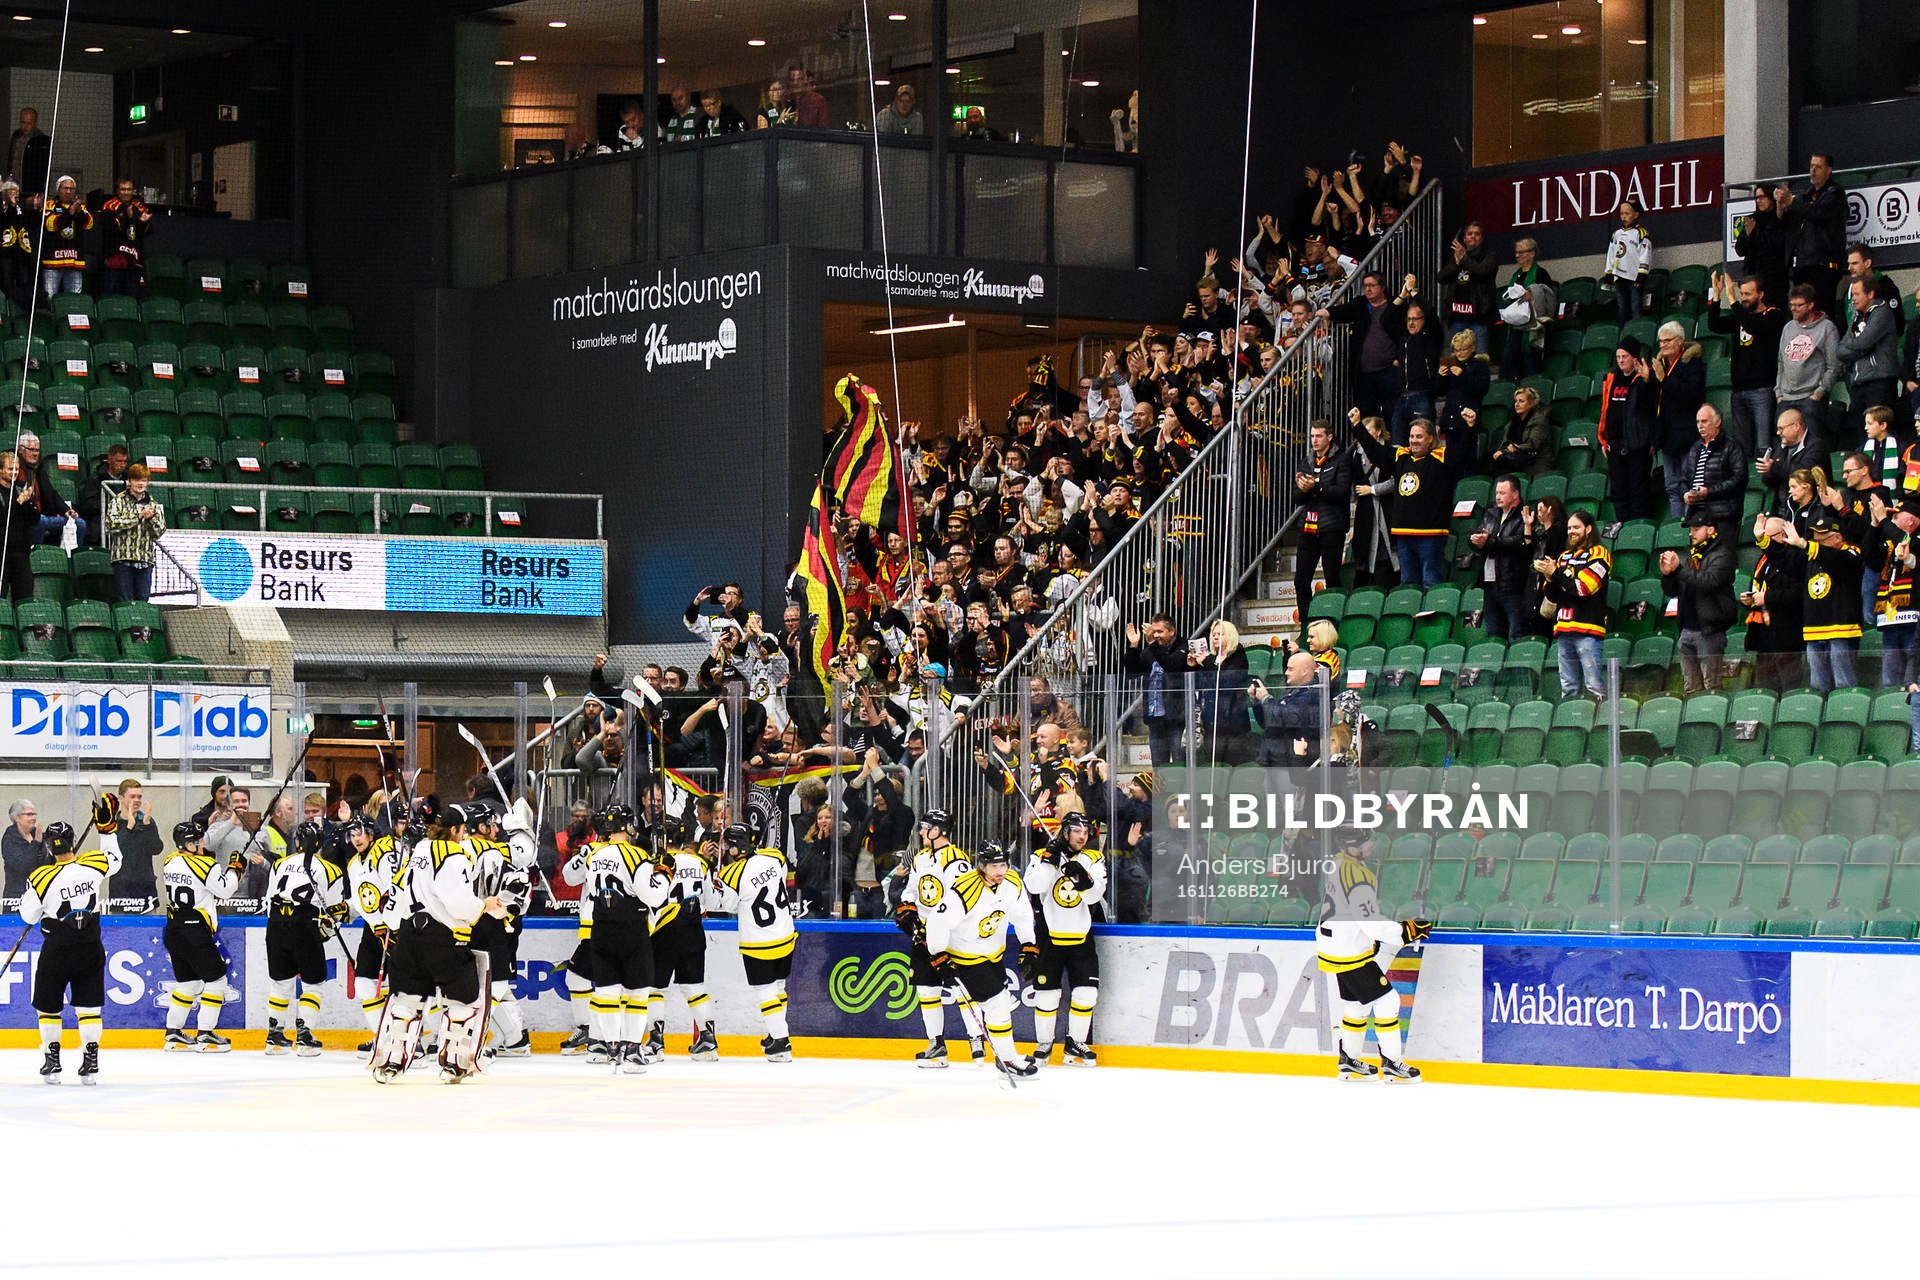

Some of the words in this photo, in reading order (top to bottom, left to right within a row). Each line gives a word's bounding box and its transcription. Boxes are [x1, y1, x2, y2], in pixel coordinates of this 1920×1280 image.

[1511, 159, 1713, 227] LINDAHL
[826, 260, 960, 289] matchvärdsloungen
[890, 284, 938, 298] samarbete
[939, 288, 960, 299] med
[962, 267, 1035, 305] Kinnarps
[553, 267, 761, 321] matchvärdsloungen
[577, 333, 618, 350] samarbete
[620, 328, 638, 345] med
[644, 322, 726, 373] Kinnarps
[261, 542, 353, 572] Resurs
[481, 549, 571, 578] Resurs
[261, 574, 326, 602] Bank
[481, 580, 545, 609] Bank
[12, 688, 130, 737] Diab
[154, 689, 269, 738] Diab
[60, 881, 94, 900] CLARK
[750, 867, 778, 888] PUDAS
[751, 877, 791, 928] 64
[1154, 950, 1334, 1052] BRA
[1490, 981, 1636, 1029] Mäklaren
[1644, 984, 1669, 1030] T.
[1678, 987, 1783, 1045] Darpö
